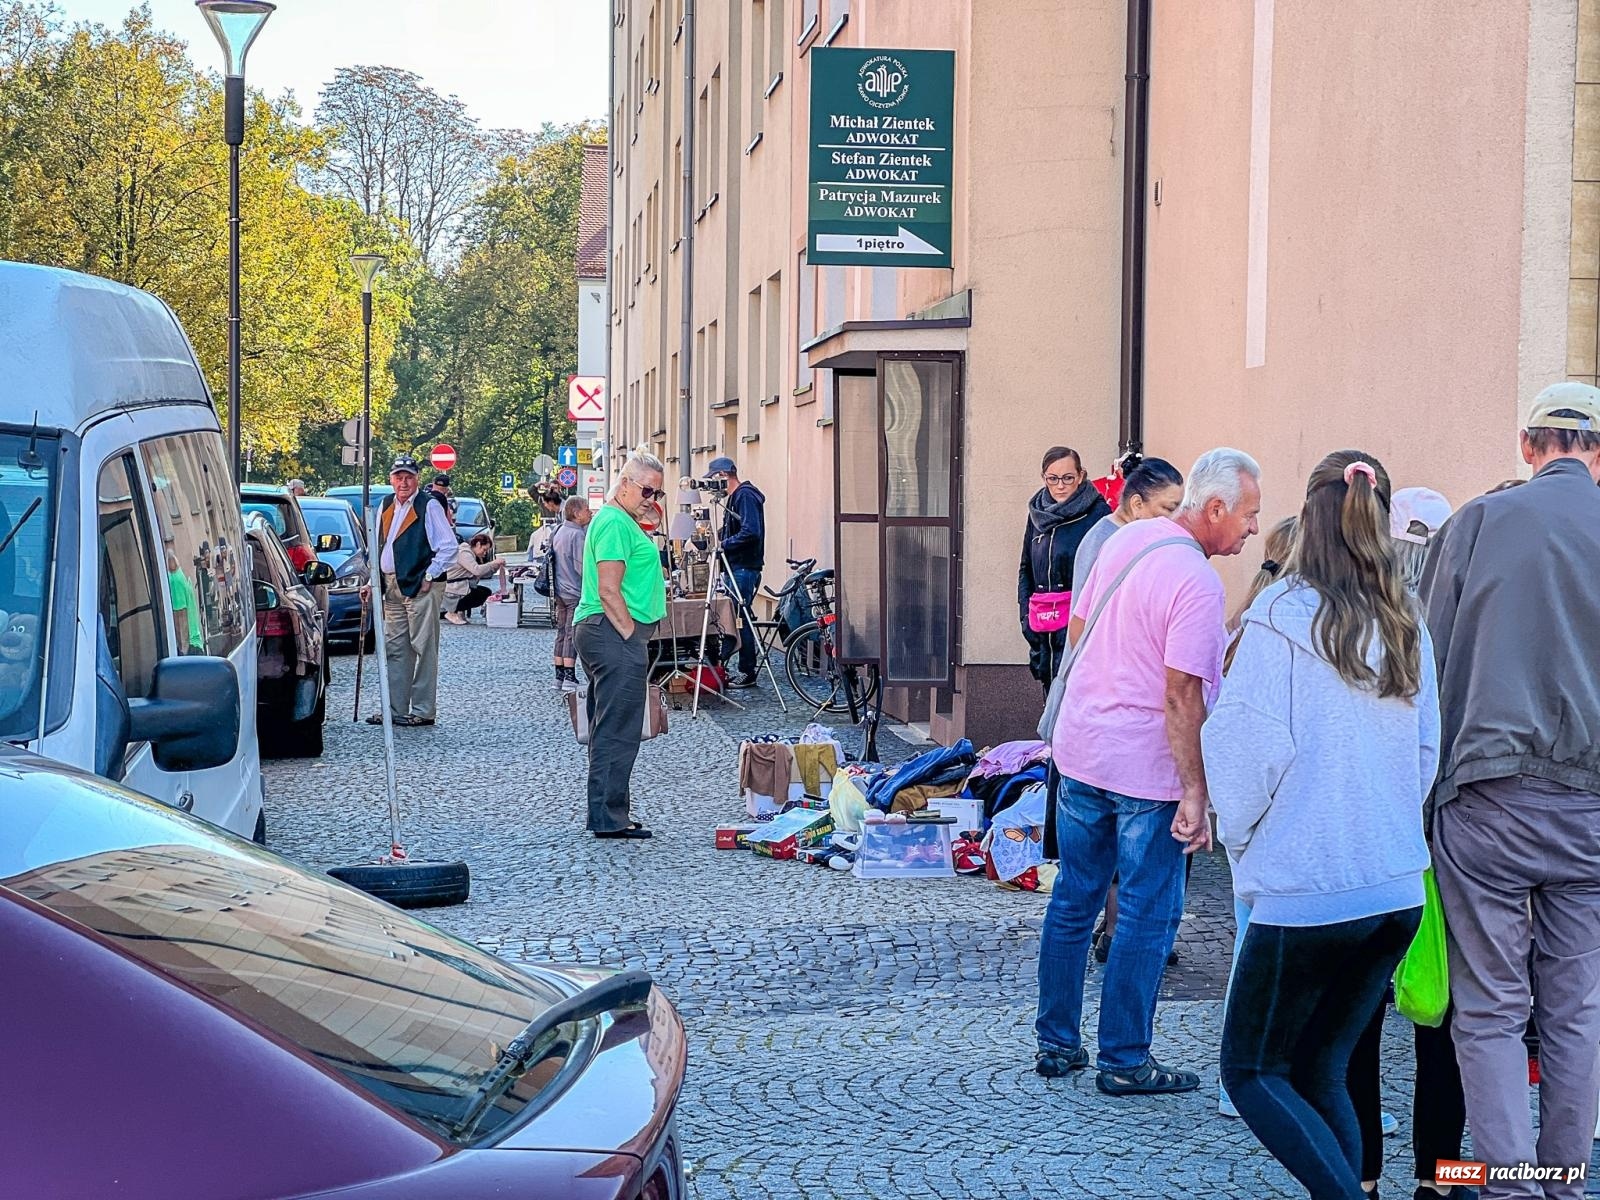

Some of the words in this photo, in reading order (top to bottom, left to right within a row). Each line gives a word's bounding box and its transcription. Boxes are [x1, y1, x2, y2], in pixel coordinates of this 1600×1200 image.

[858, 55, 892, 79] ADWOKATURA
[892, 59, 908, 79] POLSKA
[895, 84, 909, 104] HONOR
[830, 115, 878, 129] Michał
[882, 116, 935, 131] Zientek
[845, 132, 919, 145] ADWOKAT
[831, 151, 875, 165] Stefan
[879, 153, 932, 167] Zientek
[845, 168, 918, 181] ADWOKAT
[819, 188, 876, 205] Patrycja
[881, 190, 941, 204] Mazurek
[843, 206, 917, 218] ADWOKAT
[504, 475, 512, 487] P
